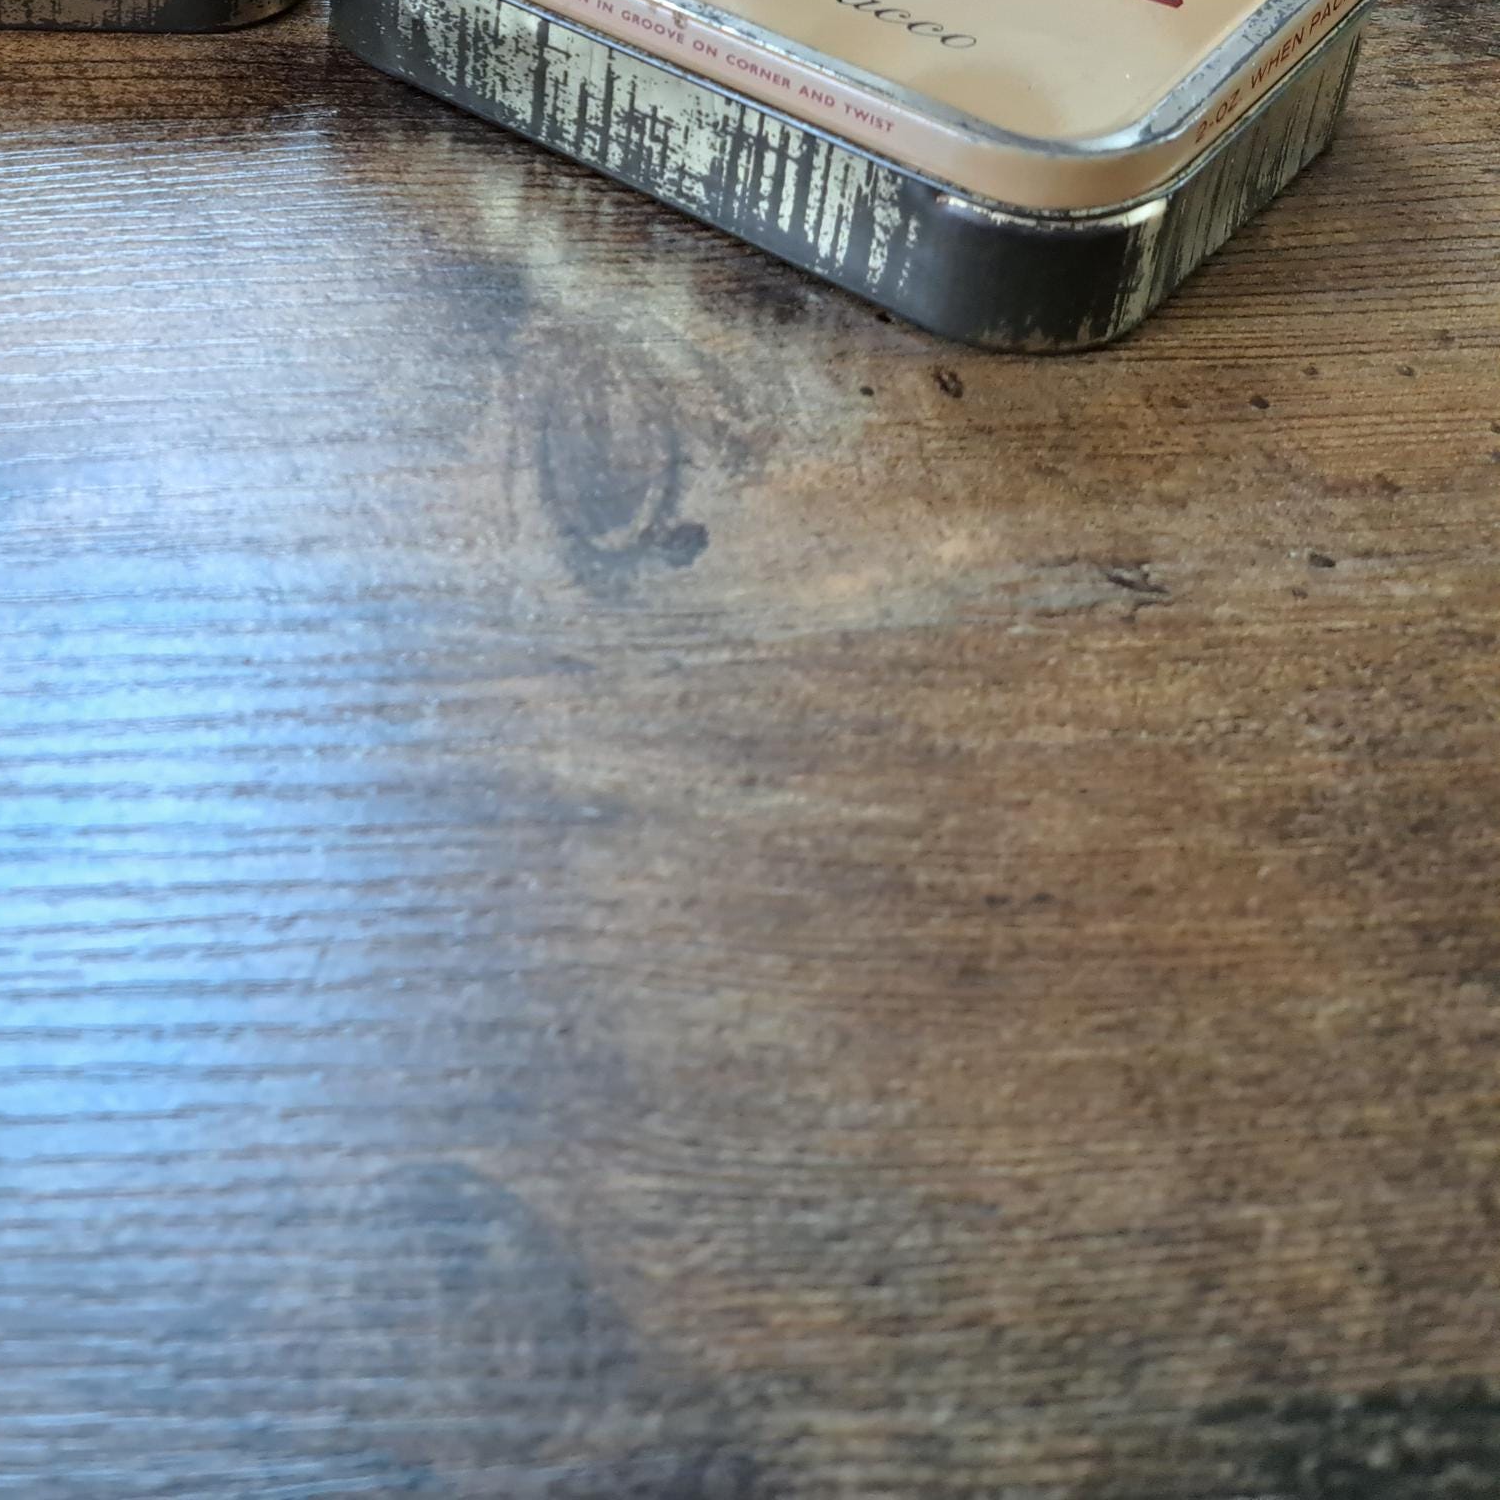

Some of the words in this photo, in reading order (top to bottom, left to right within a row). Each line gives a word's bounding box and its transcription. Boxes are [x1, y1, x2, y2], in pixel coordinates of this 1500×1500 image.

[621, 9, 685, 45] GROOVE
[692, 39, 718, 58] ON
[725, 53, 792, 90] CORNER
[798, 84, 836, 109] AND
[843, 103, 895, 134] TWIST
[1251, 26, 1305, 88] WHEN
